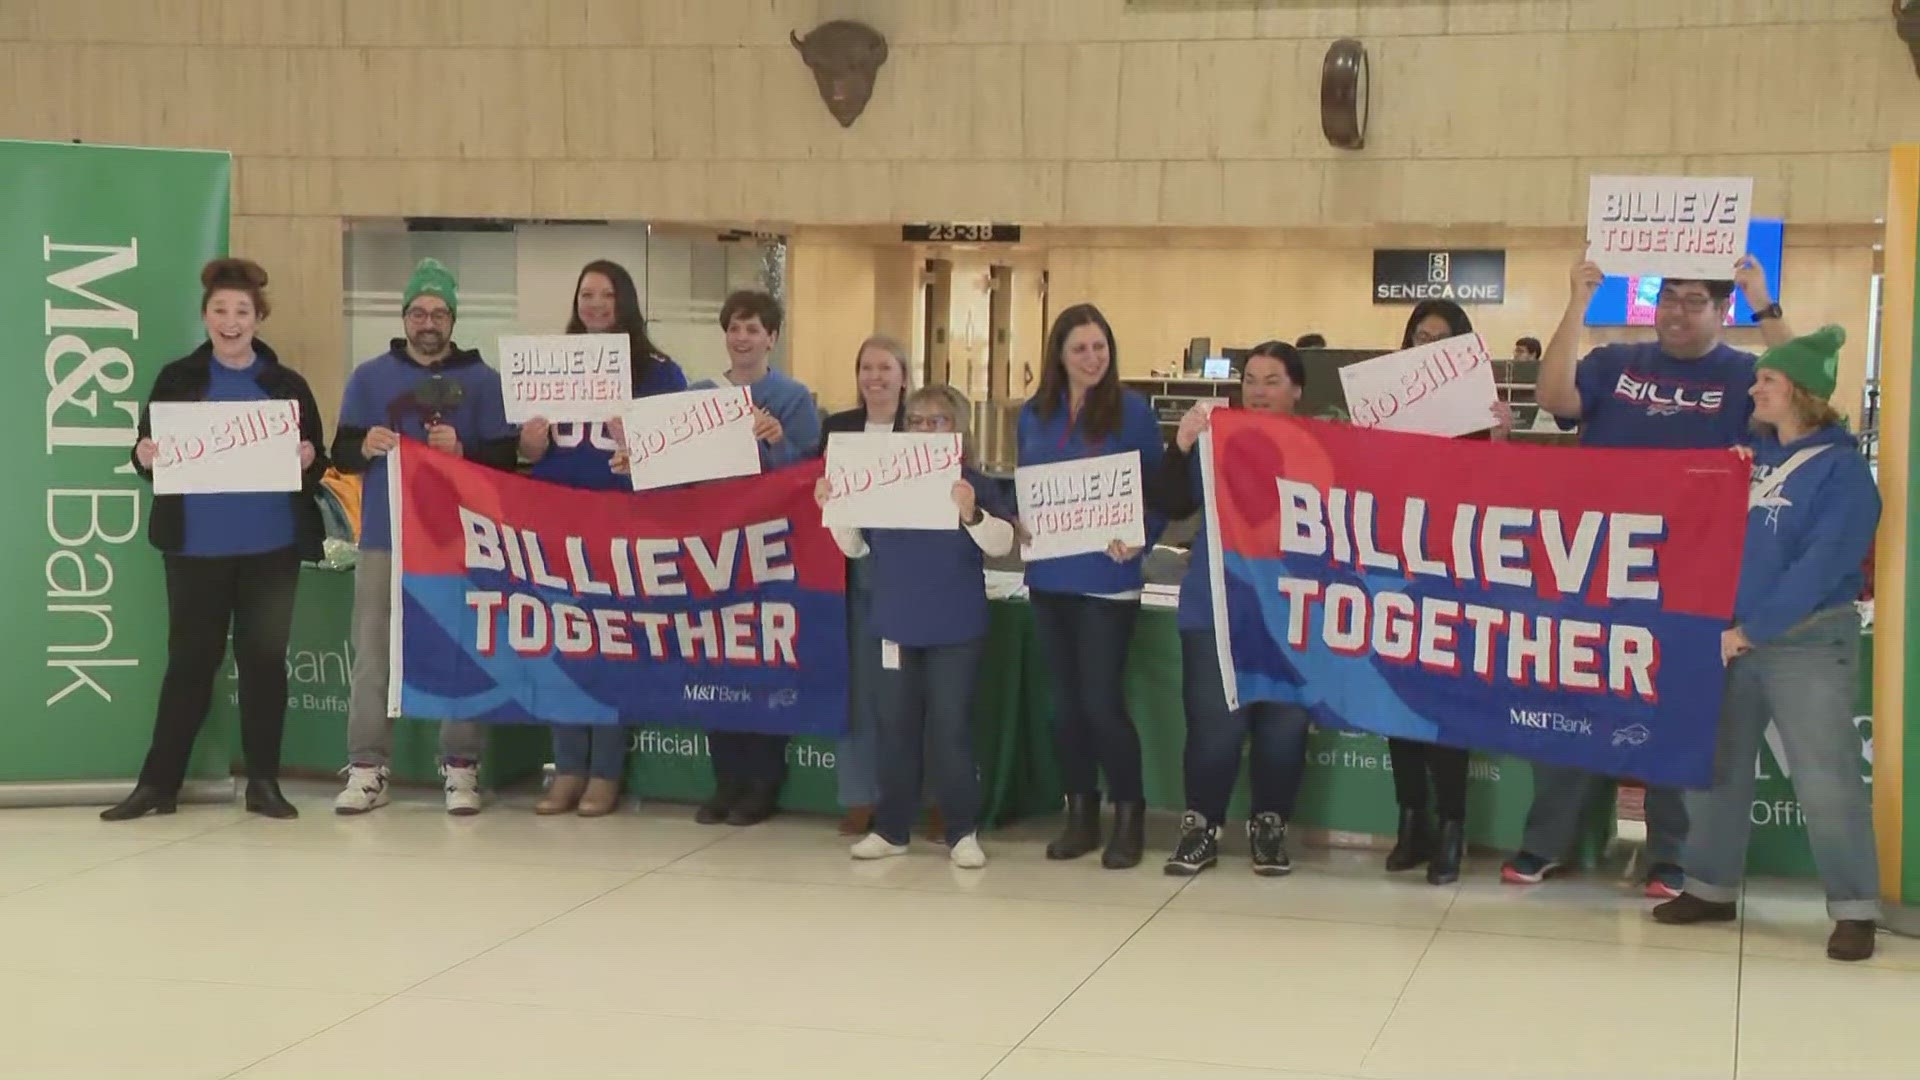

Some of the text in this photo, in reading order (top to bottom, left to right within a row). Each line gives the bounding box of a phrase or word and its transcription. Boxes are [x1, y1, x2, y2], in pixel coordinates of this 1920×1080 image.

[1602, 191, 1738, 224] BILLIEVE
[928, 223, 994, 240] 23-38
[1602, 228, 1735, 255] TOGETHER
[1377, 284, 1499, 299] SENECA ONE
[511, 346, 620, 375] BILLIEVE
[511, 379, 622, 401] TOGETHER
[1353, 332, 1492, 430] Go Bills!
[1614, 373, 1724, 409] BILLS
[156, 400, 302, 468] Go Bills!
[630, 429, 666, 463] Go
[669, 385, 755, 445] Bills!
[44, 235, 139, 707] M&T Bank
[830, 434, 967, 499] Go Bills!
[1029, 468, 1133, 508] BILLIEVE
[1032, 502, 1134, 536] TOGETHER
[458, 504, 797, 598] BILLIEVE
[1275, 476, 1666, 600] BILLIEVE
[465, 590, 799, 668] TOGETHER
[1277, 576, 1660, 702] TOGETHER
[1509, 708, 1592, 735] M&T Bank
[797, 744, 836, 770] the
[1318, 749, 1338, 767] of
[1344, 750, 1378, 770] the
[1750, 800, 1807, 826] Offi
